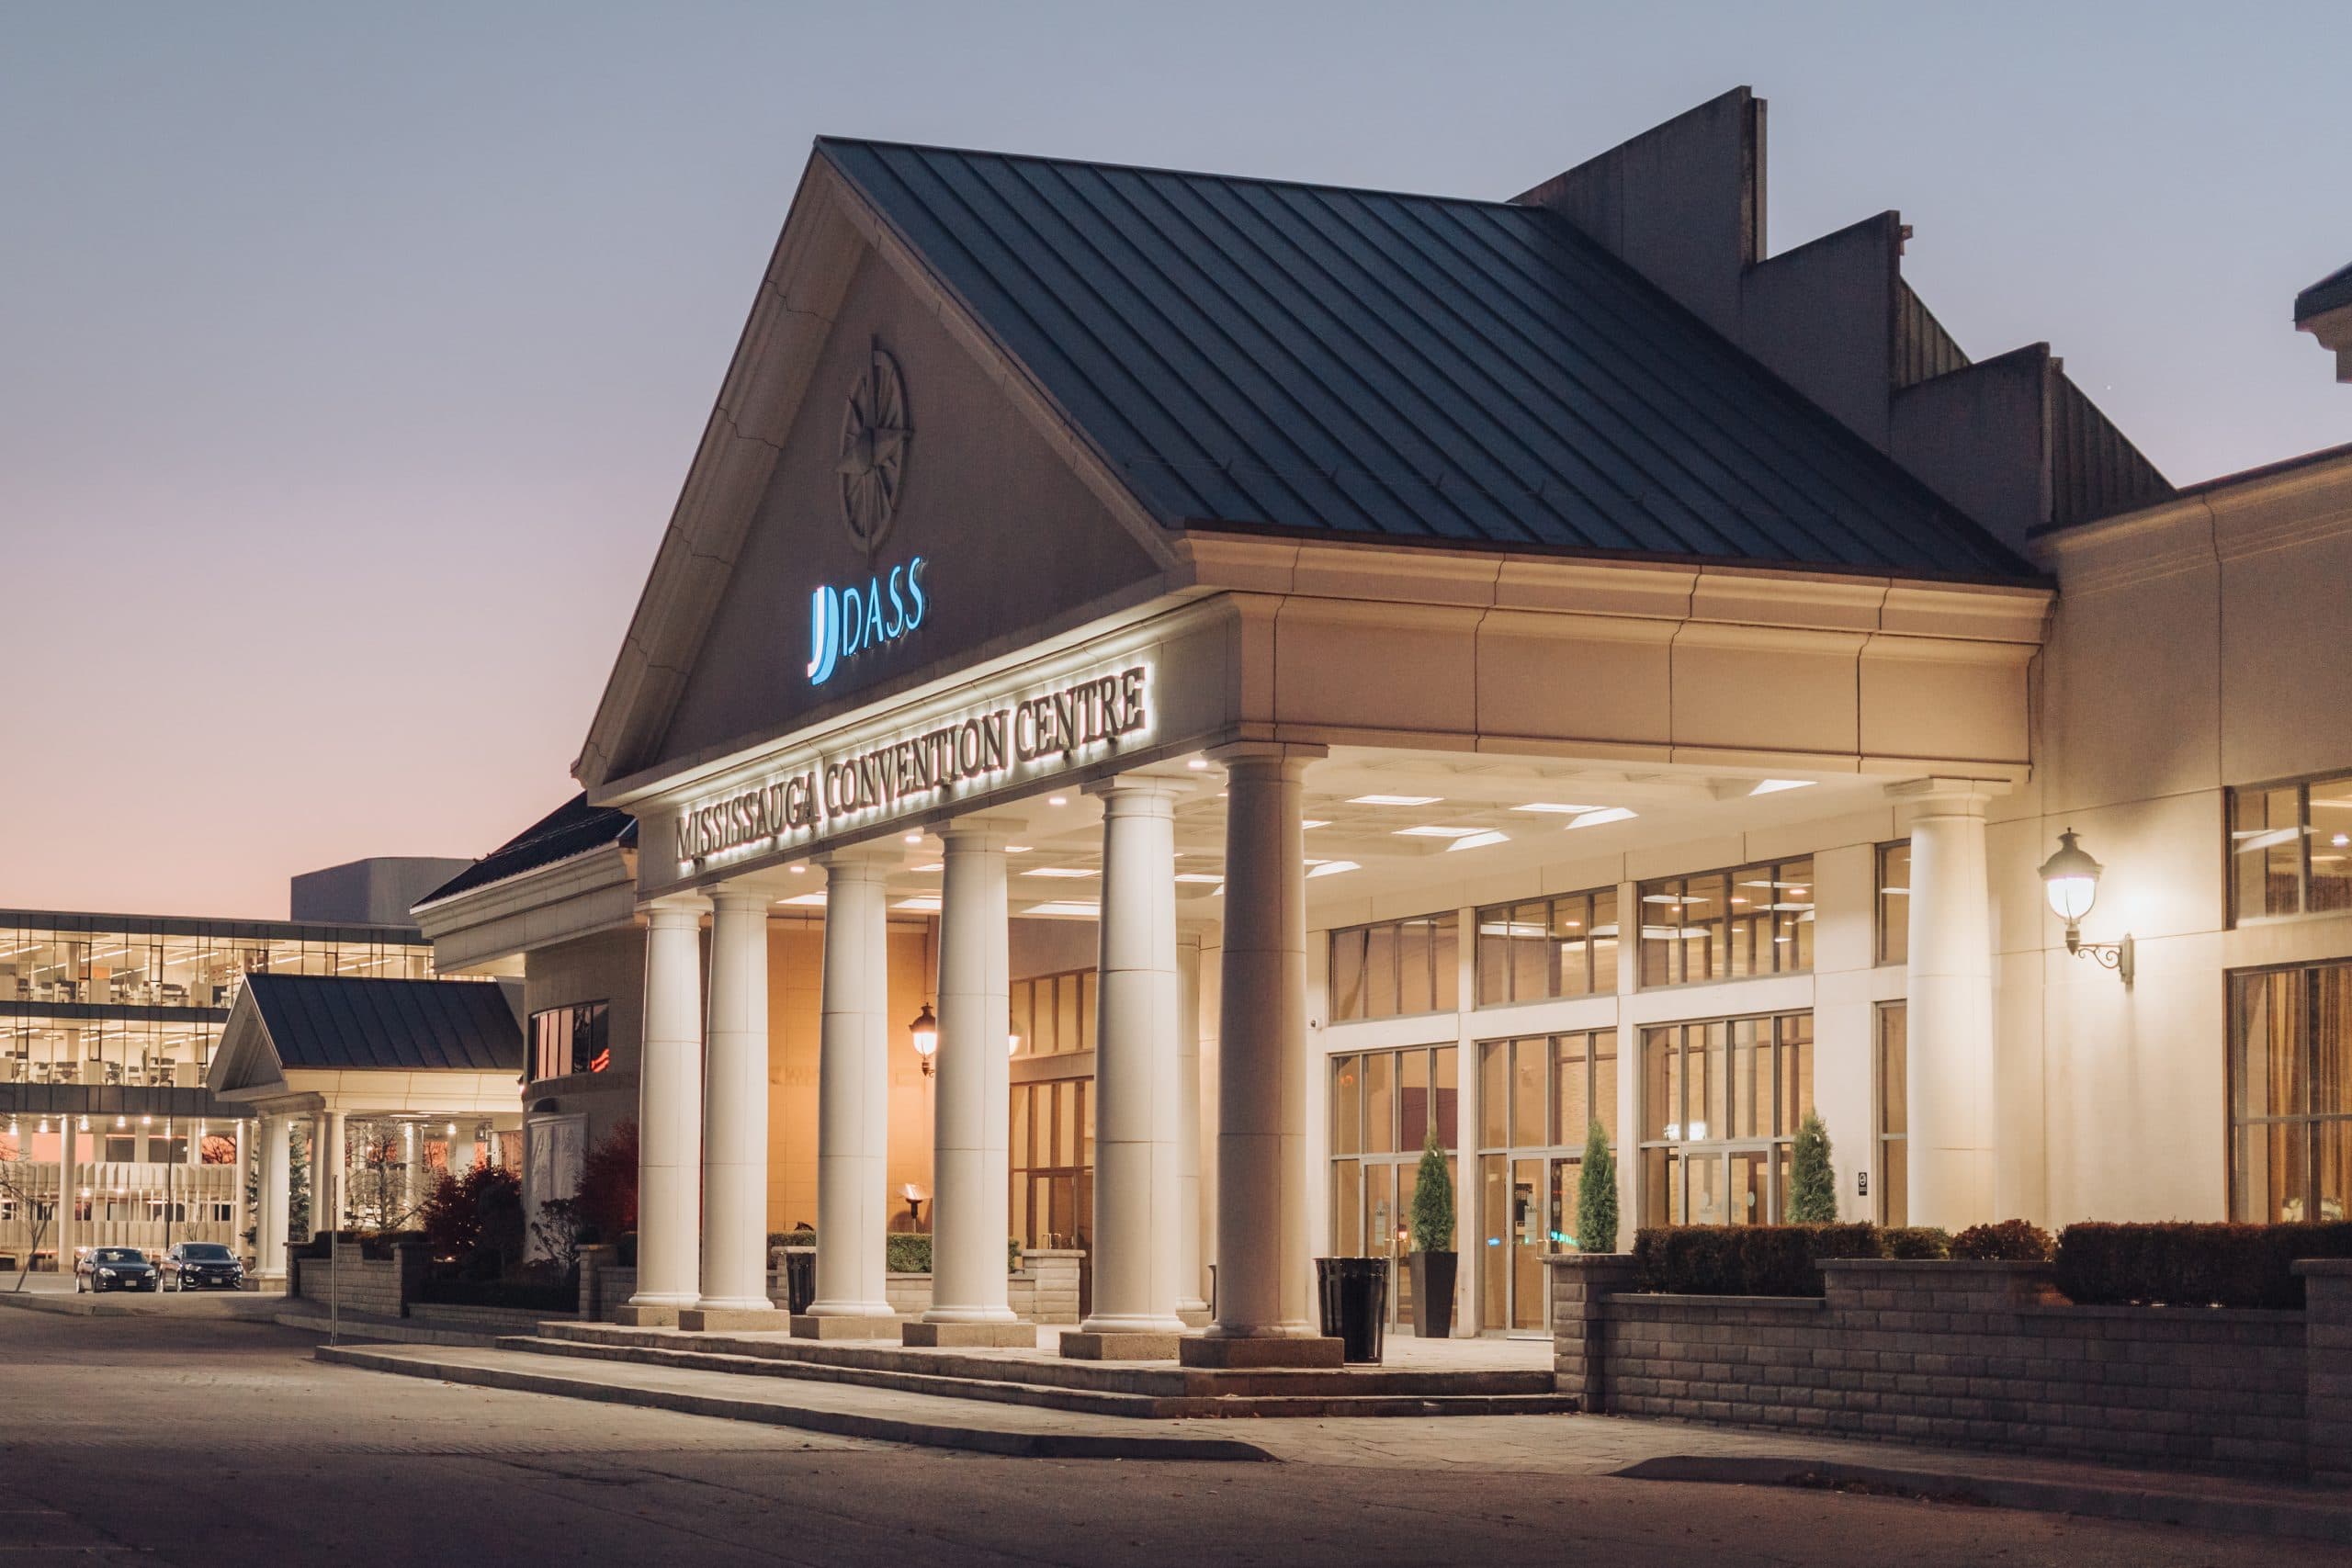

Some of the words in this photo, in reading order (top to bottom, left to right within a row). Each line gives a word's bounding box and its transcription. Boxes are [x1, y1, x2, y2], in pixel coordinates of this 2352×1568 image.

[675, 771, 821, 863] MISSISSAUGA
[824, 709, 1011, 818] CONVENTION
[1015, 666, 1146, 762] CENTRE
